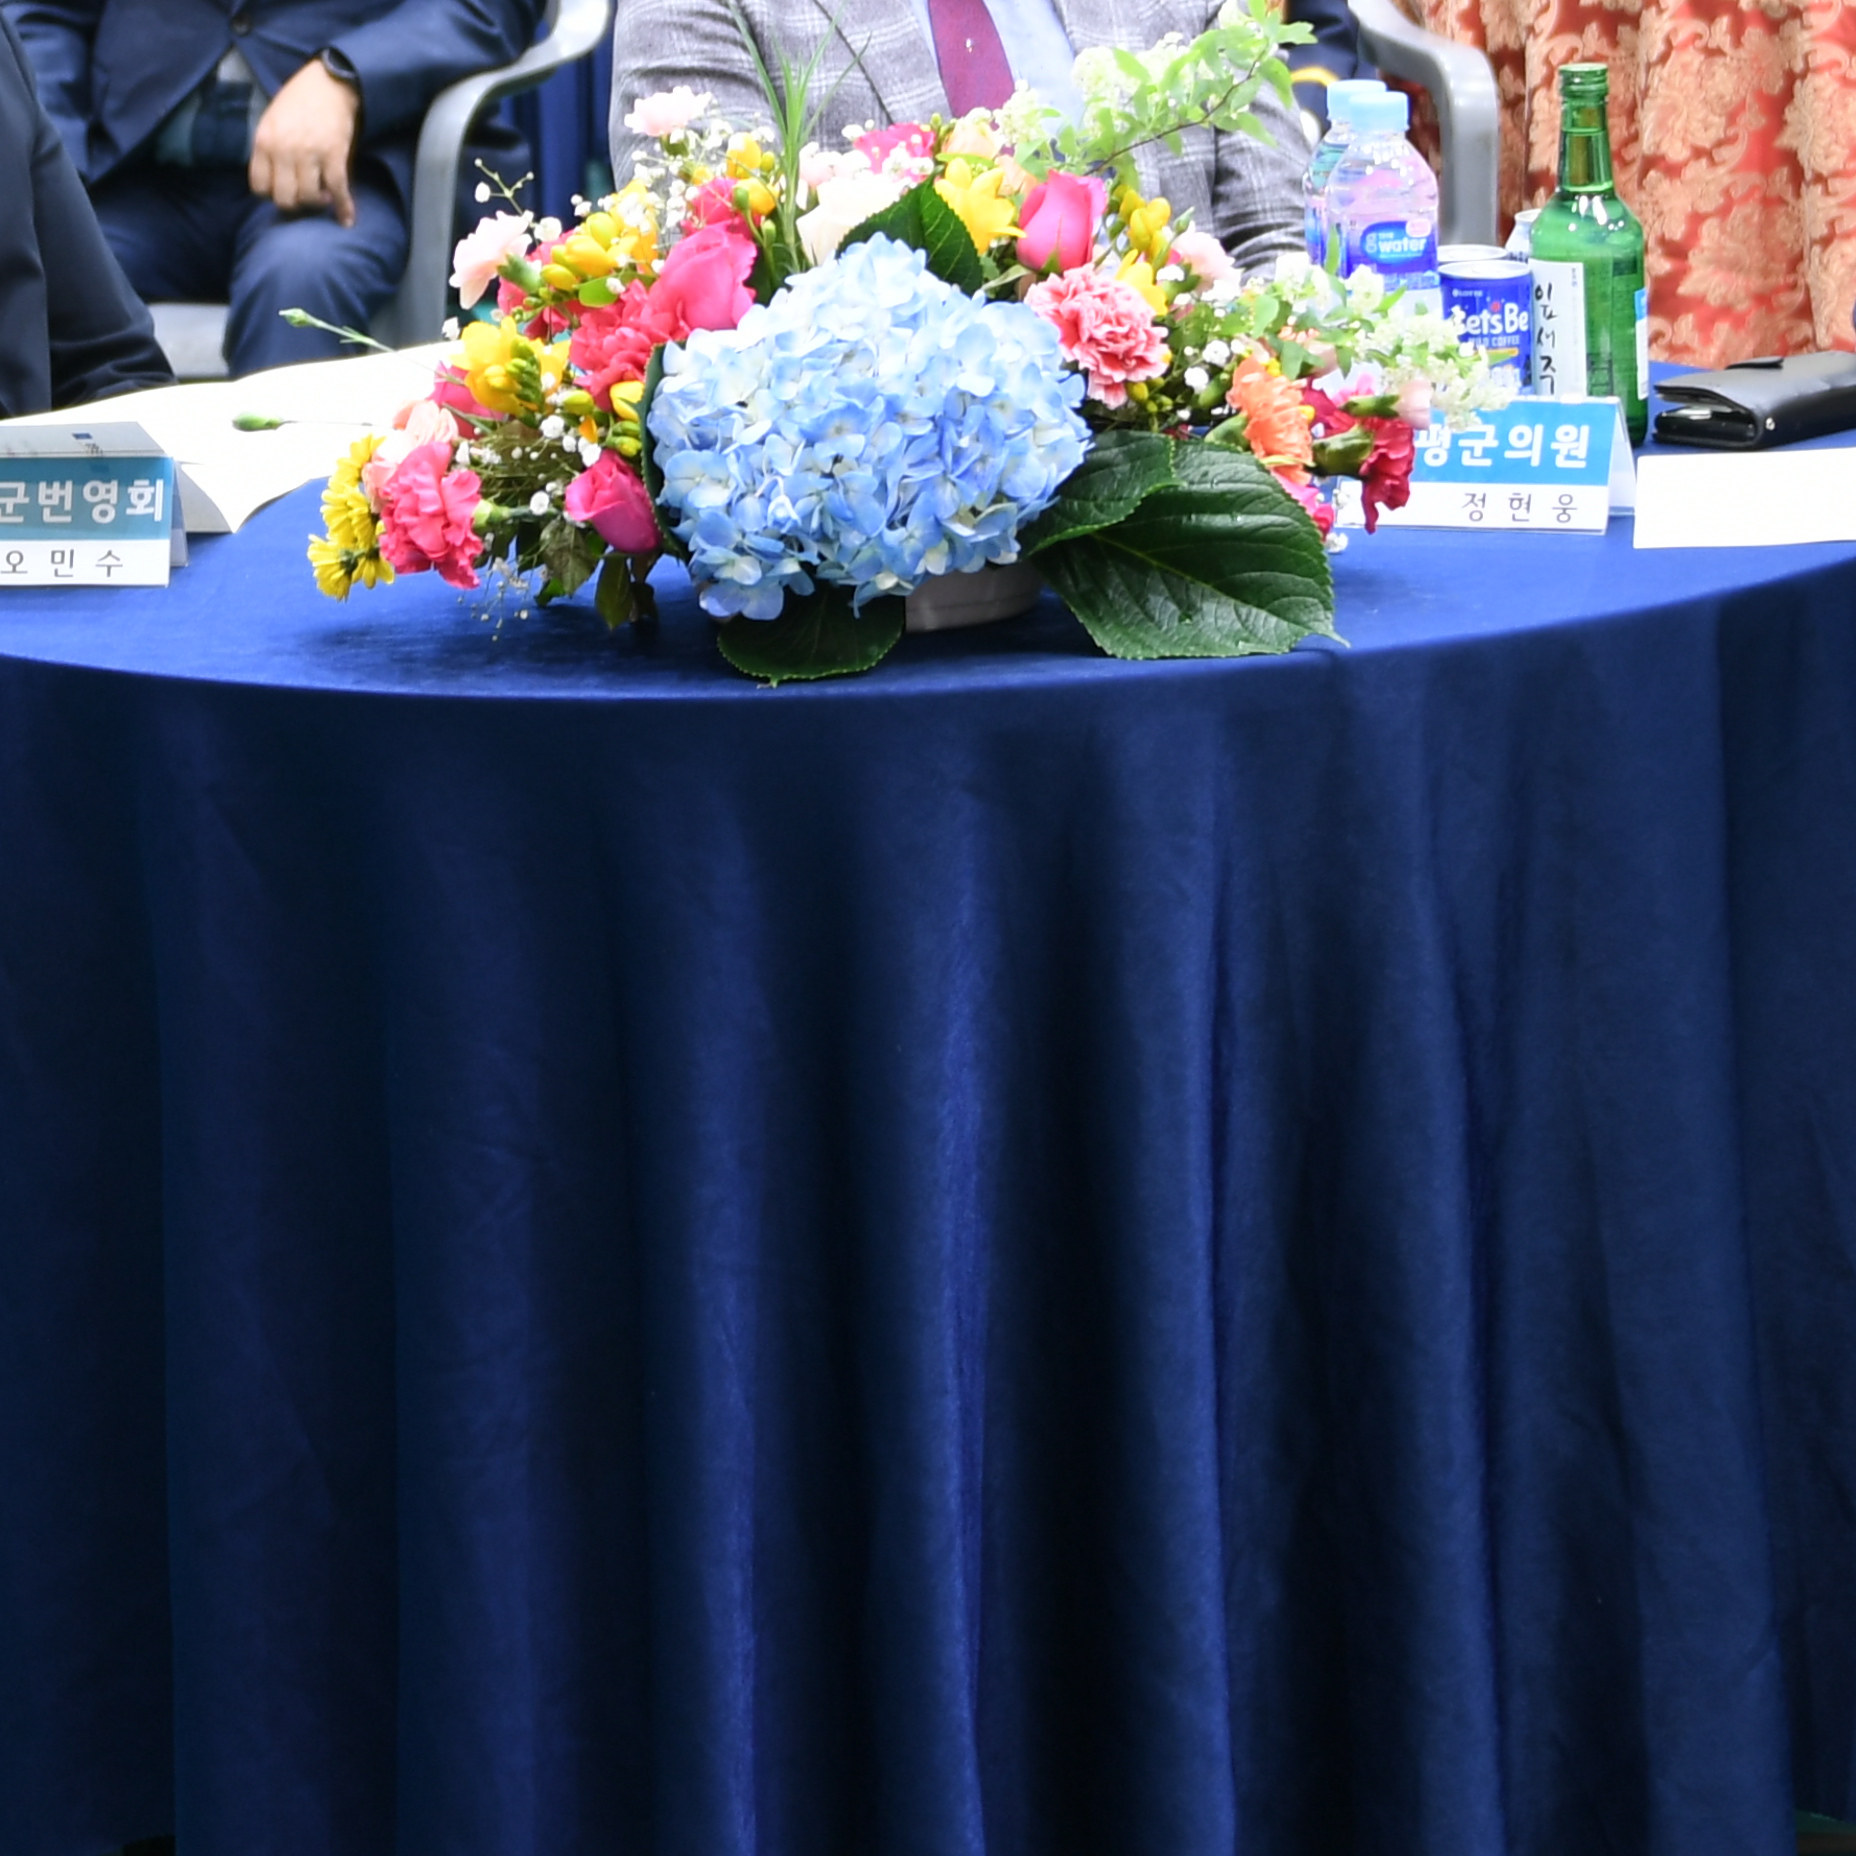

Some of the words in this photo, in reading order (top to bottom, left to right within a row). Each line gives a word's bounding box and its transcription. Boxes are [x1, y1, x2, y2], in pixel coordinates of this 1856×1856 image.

[1378, 236, 1427, 253] water
[1533, 281, 1558, 396] 잎새주
[1415, 423, 1590, 469] 평군의원
